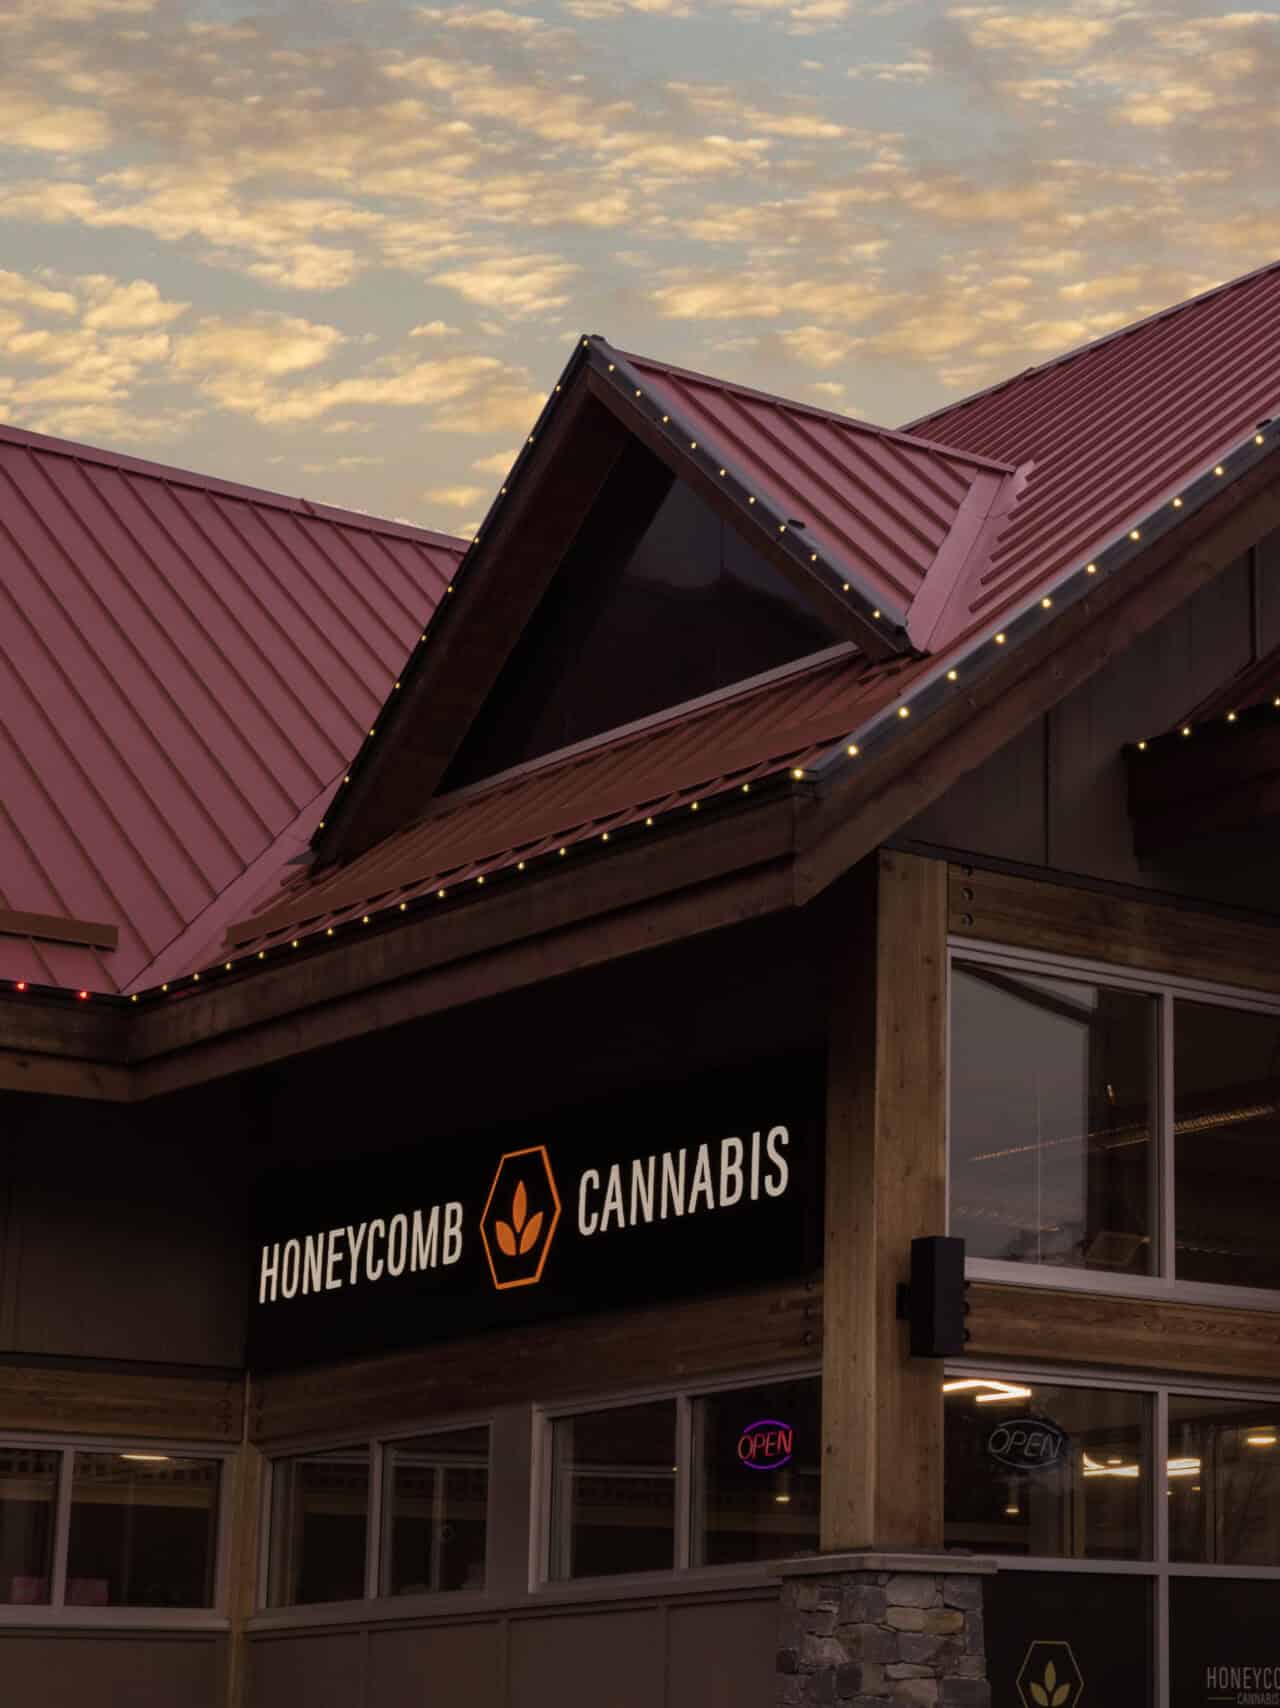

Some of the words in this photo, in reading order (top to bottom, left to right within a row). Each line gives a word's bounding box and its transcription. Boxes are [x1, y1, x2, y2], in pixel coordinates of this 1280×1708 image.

[258, 1201, 464, 1303] HONEYCOMB
[578, 1125, 790, 1237] CANNABIS
[737, 1429, 794, 1462] OPEN
[987, 1428, 1064, 1458] OPEN
